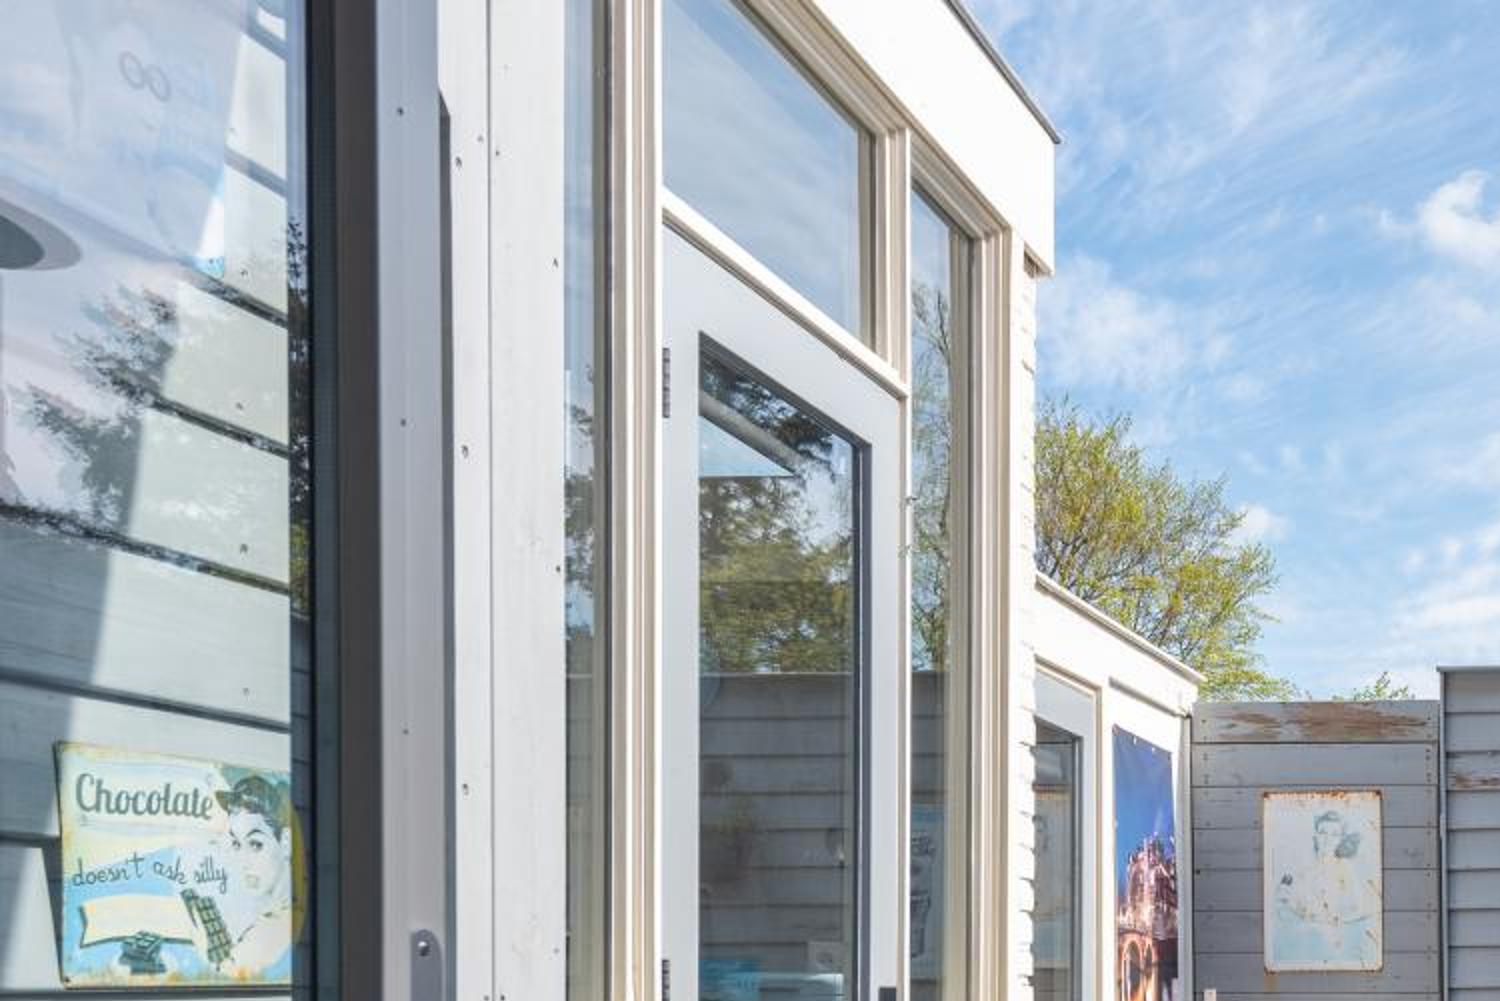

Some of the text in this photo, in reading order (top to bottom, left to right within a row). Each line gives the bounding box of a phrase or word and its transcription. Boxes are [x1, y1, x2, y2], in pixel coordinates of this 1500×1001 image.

[75, 772, 213, 820] Chocolate
[153, 855, 187, 885] ask
[193, 855, 228, 895] silly
